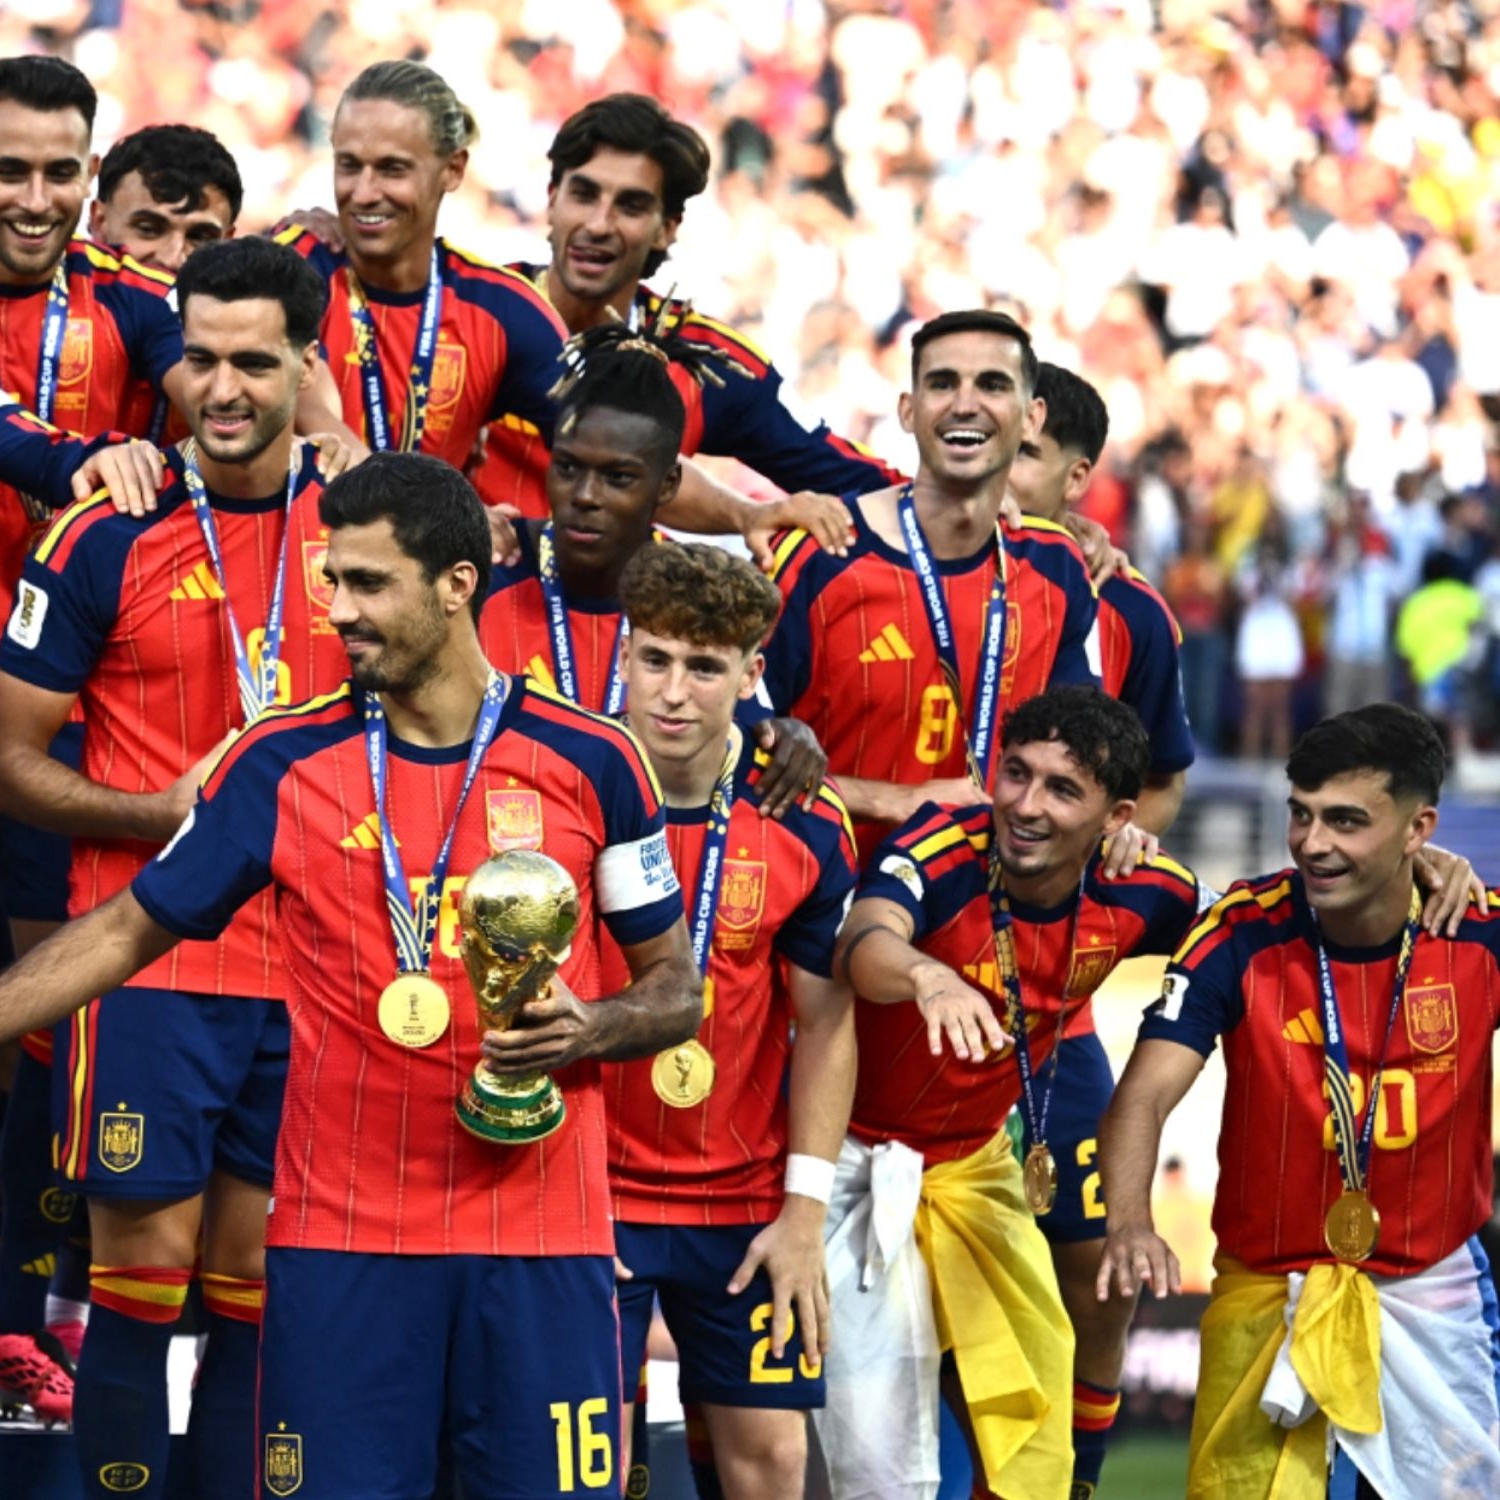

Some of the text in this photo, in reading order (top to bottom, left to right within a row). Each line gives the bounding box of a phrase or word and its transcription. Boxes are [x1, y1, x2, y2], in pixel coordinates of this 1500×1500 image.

[419, 330, 433, 357] FIFA
[39, 385, 51, 421] ORLD
[368, 376, 387, 448] FIFA WORLD
[923, 575, 946, 626] WORLD
[551, 595, 574, 698] FIFA WORLD CUP
[937, 623, 950, 648] FIFA
[984, 656, 997, 684] CUP
[915, 685, 958, 764] 8
[977, 683, 995, 732] WORLD
[975, 728, 988, 758] FIFA
[699, 892, 711, 918] CUP
[1325, 998, 1339, 1045] 2026
[1323, 1068, 1418, 1150] 20
[549, 1397, 613, 1492] 16
